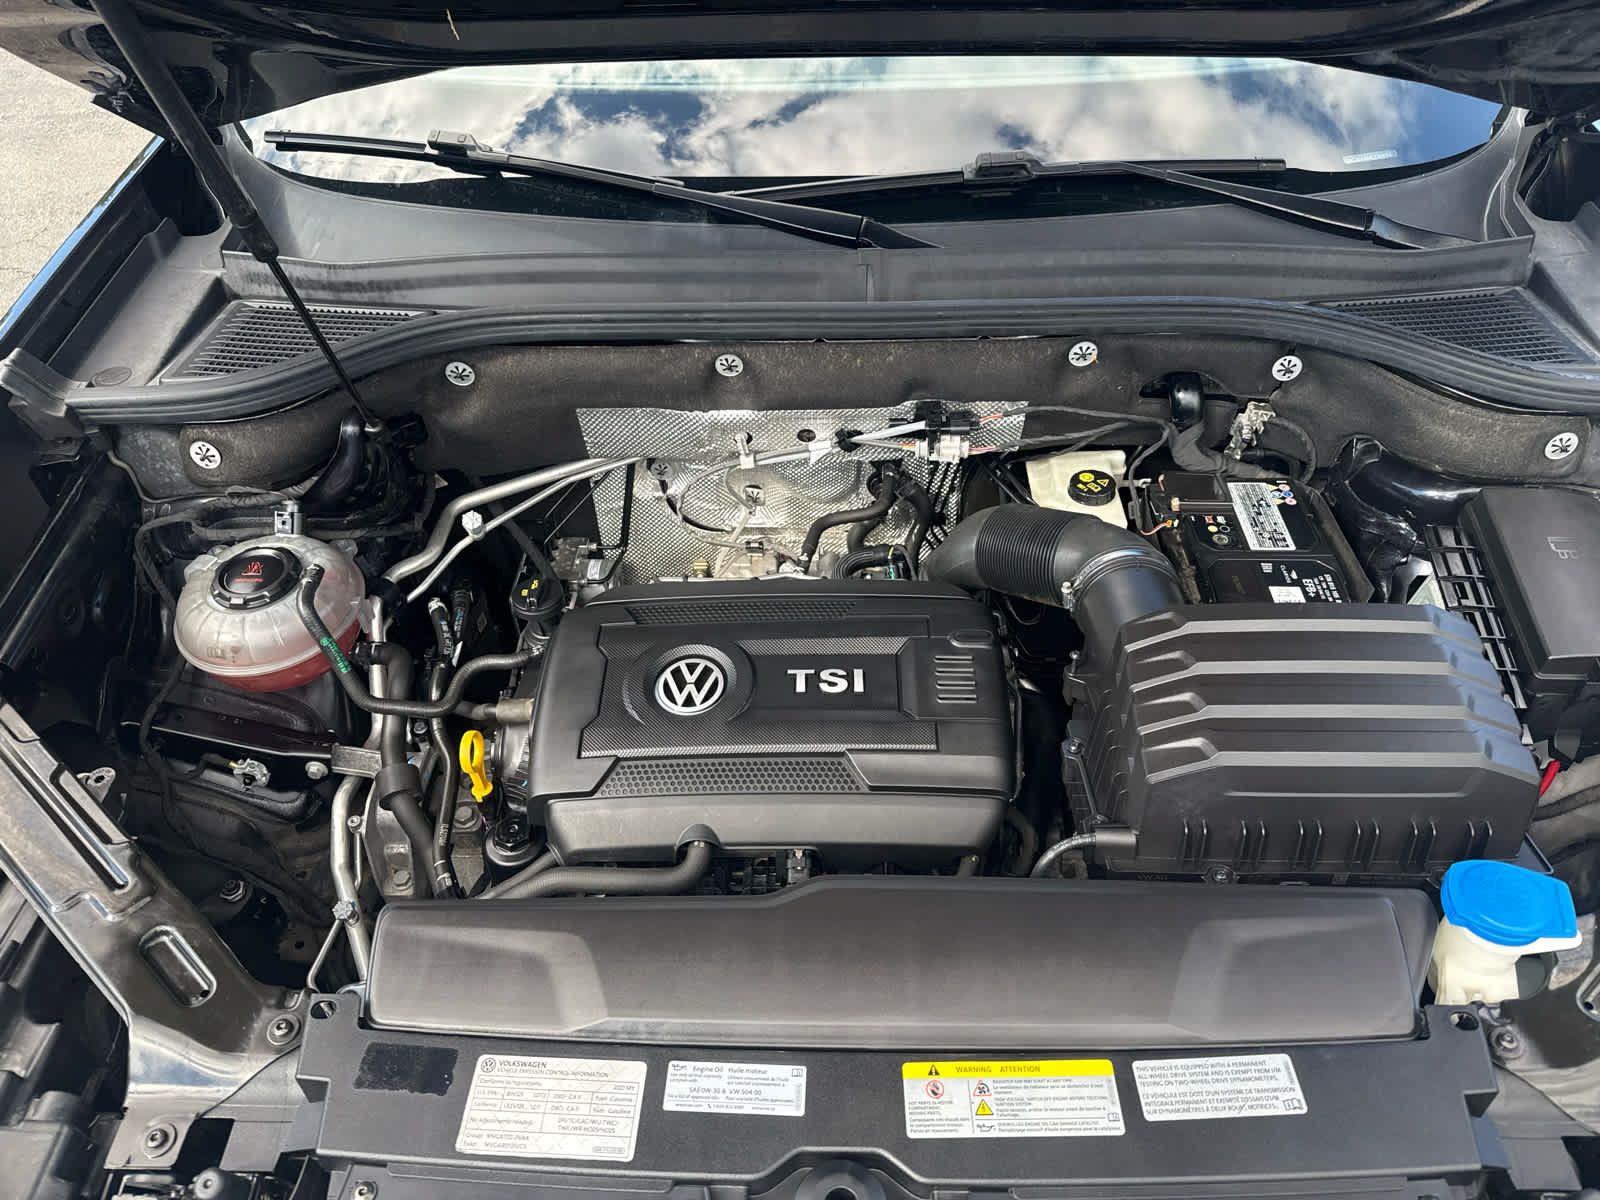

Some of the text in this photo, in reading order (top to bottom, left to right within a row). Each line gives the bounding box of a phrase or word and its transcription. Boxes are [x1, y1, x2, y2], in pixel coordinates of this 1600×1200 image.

[787, 668, 865, 693] TSI
[498, 1060, 547, 1069] VOLKSWAGEN
[999, 1065, 1041, 1073] ATTENTION
